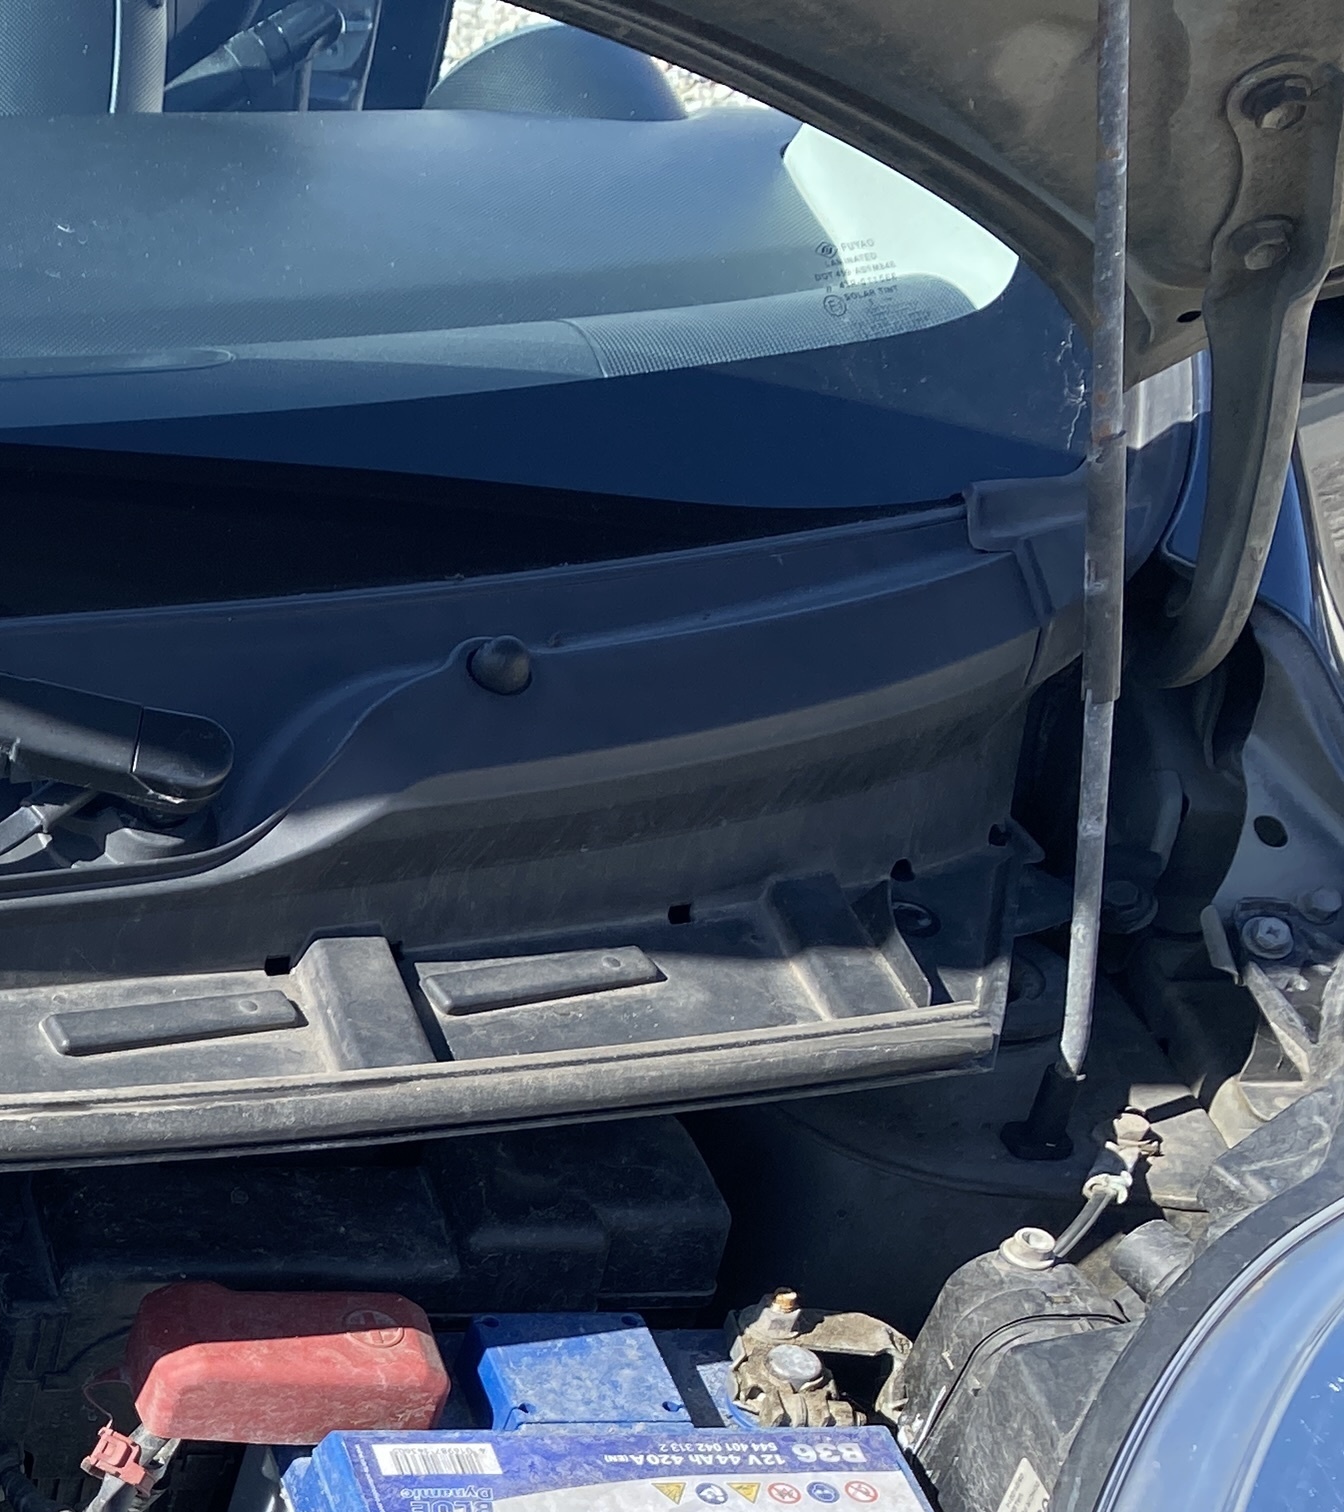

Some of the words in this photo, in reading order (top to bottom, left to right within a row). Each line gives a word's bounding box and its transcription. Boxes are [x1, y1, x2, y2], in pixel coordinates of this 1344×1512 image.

[659, 1443, 668, 1451] 2
[696, 1442, 720, 1451] 042
[725, 1442, 748, 1451] 401
[750, 1442, 777, 1451] 544
[791, 1442, 866, 1463] B36
[748, 1454, 785, 1465] 12V
[400, 1485, 493, 1500] Dynamic
